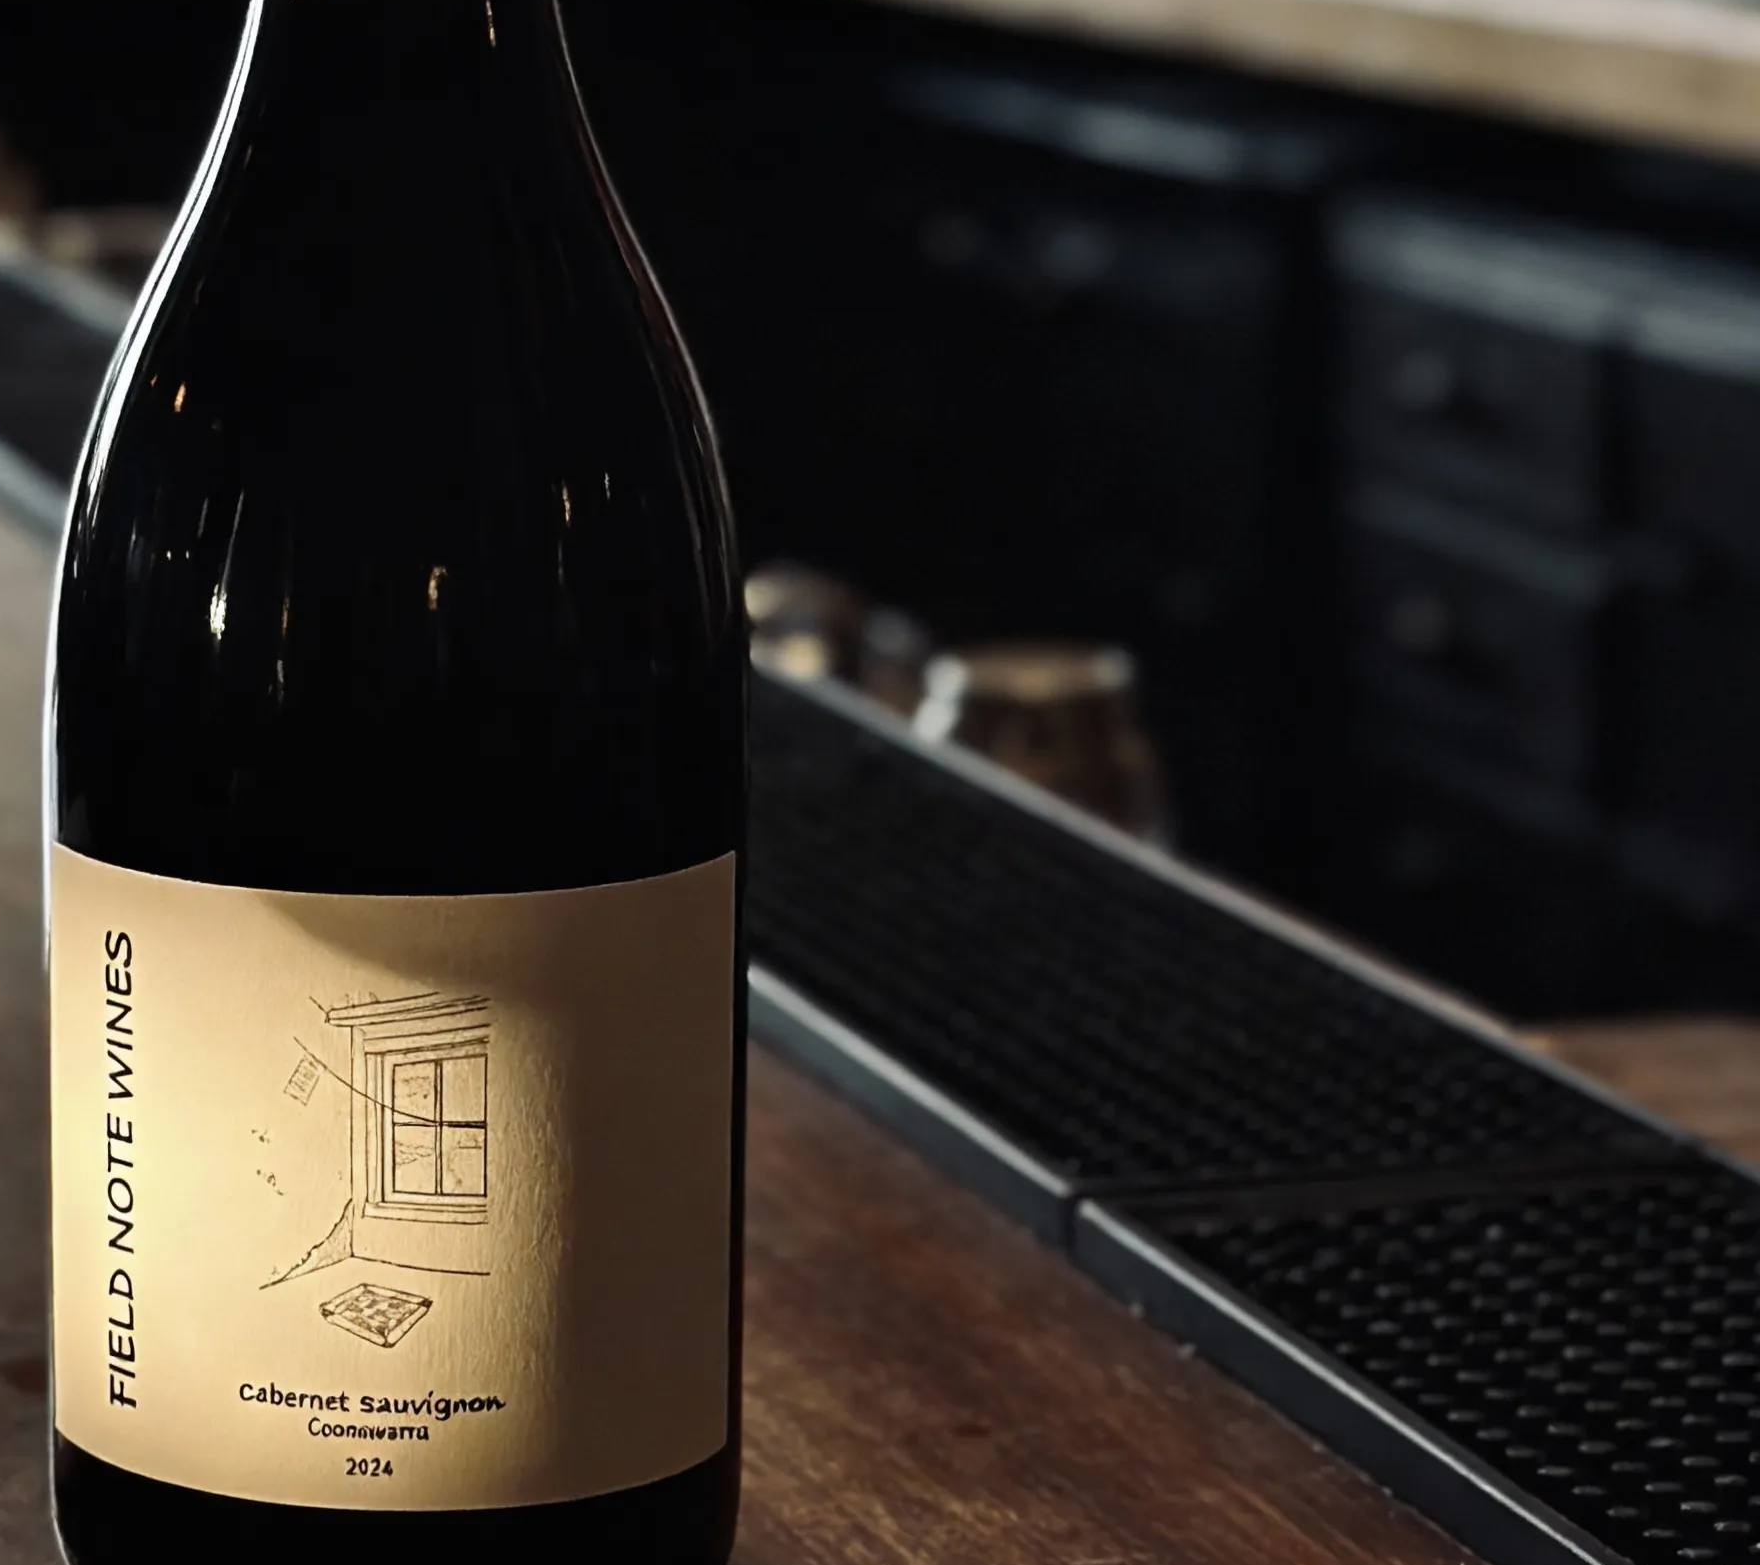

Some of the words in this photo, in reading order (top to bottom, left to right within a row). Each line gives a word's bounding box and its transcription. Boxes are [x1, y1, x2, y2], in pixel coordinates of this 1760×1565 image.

[104, 929, 134, 1100] WINES
[106, 1112, 136, 1255] NOTE
[107, 1268, 138, 1409] FIELD
[344, 1456, 395, 1478] 2024
